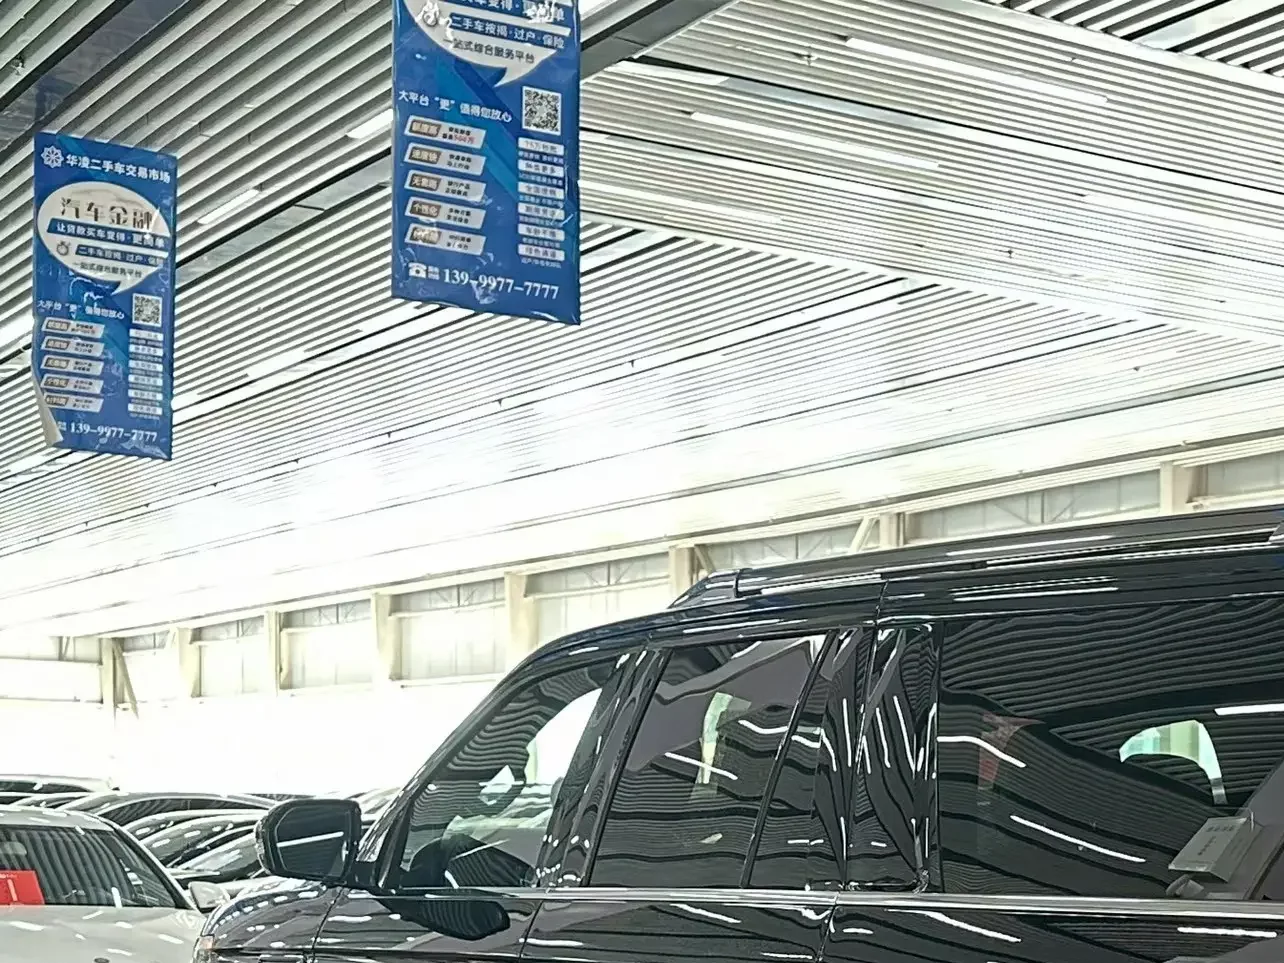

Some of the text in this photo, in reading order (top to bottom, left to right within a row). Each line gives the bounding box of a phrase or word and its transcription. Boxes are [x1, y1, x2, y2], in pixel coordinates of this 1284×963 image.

[398, 90, 430, 107] 大平台
[460, 102, 513, 123] 值得您放心
[66, 153, 171, 184] 华凌二手车交易市场
[443, 268, 560, 300] 139-9977-7777
